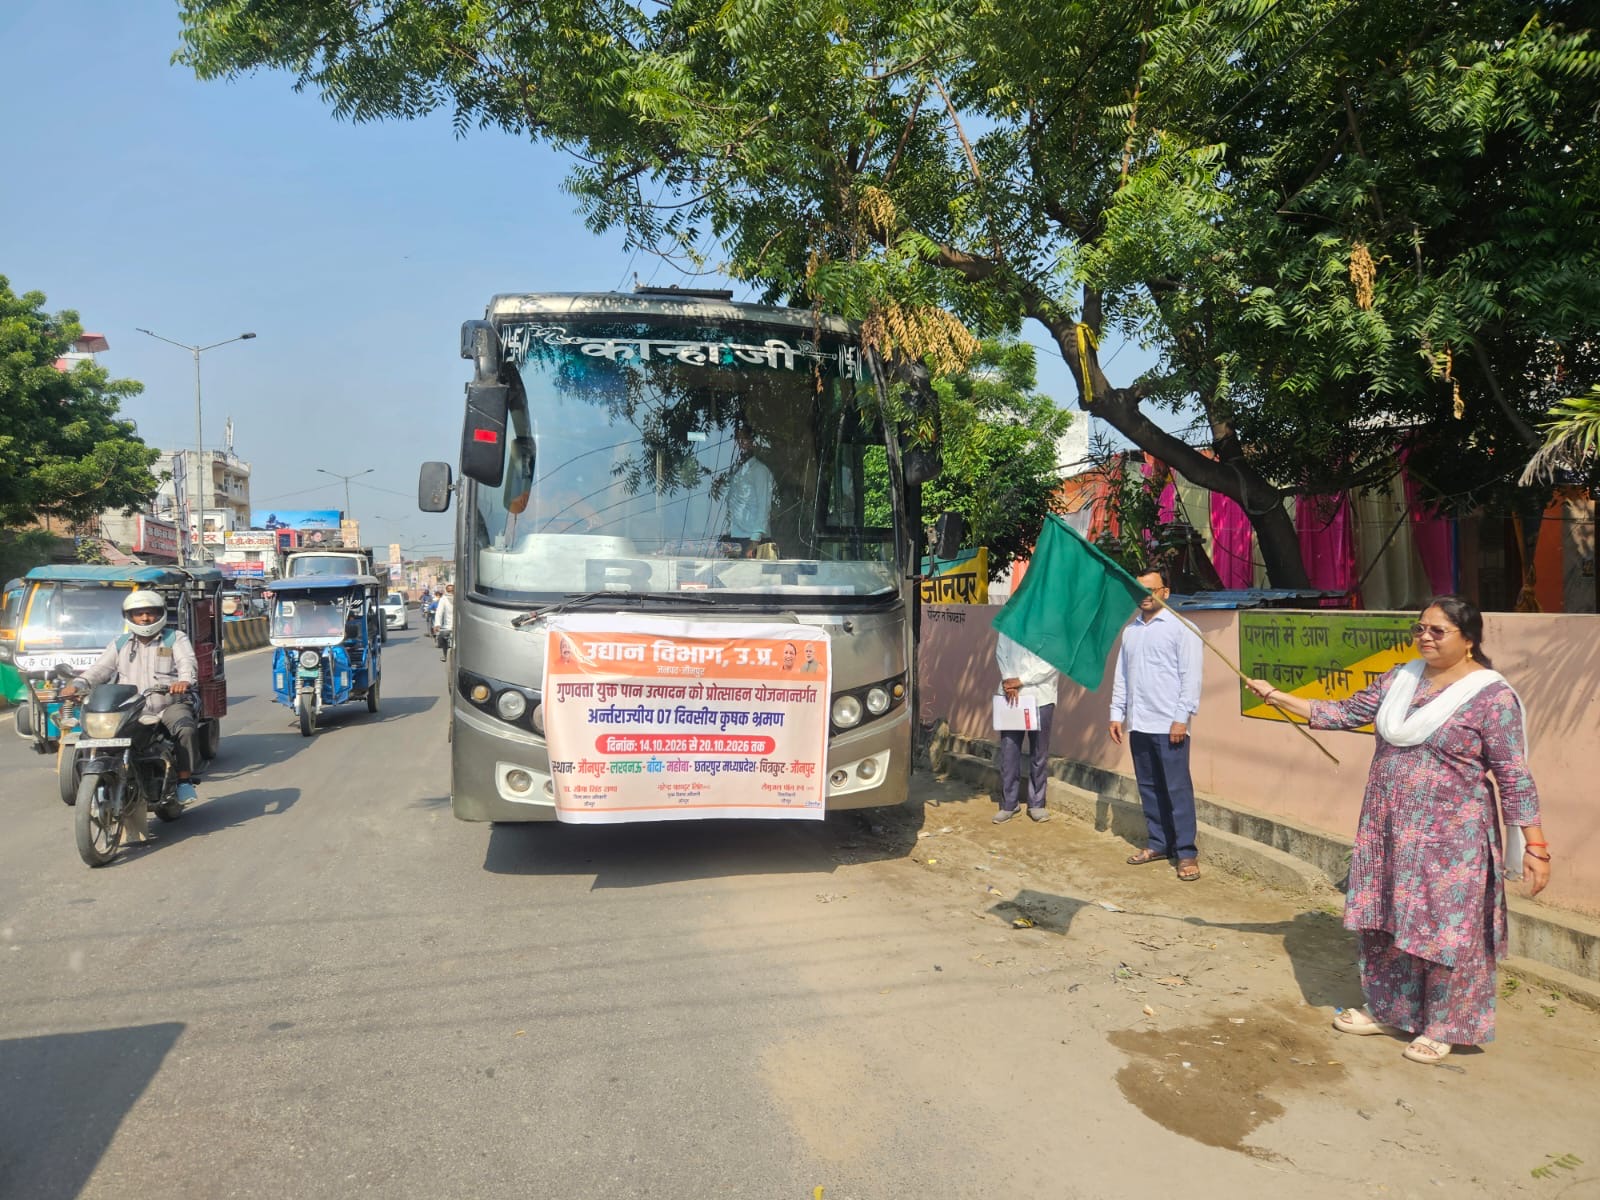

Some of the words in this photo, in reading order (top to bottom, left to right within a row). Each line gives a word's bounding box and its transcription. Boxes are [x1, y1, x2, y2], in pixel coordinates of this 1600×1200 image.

[727, 338, 796, 371] जी
[1301, 626, 1329, 648] आग
[582, 641, 647, 663] उद्यान
[651, 639, 729, 668] विभाग,
[1272, 659, 1308, 686] बंजर
[556, 682, 594, 703] गुणवत्ता
[596, 682, 618, 702] युक्त
[620, 684, 643, 698] पान
[645, 685, 687, 699] उत्पादन
[688, 682, 704, 700] को
[705, 683, 753, 702] प्रोत्साहन
[657, 709, 672, 724] 07
[674, 705, 718, 726] दिवसीय
[719, 711, 750, 732] कृषक
[752, 712, 785, 727] भ्रमण
[606, 736, 638, 752] दिनांक:
[688, 736, 699, 751] से
[751, 741, 766, 753] तक
[694, 760, 721, 777] छतरपुर
